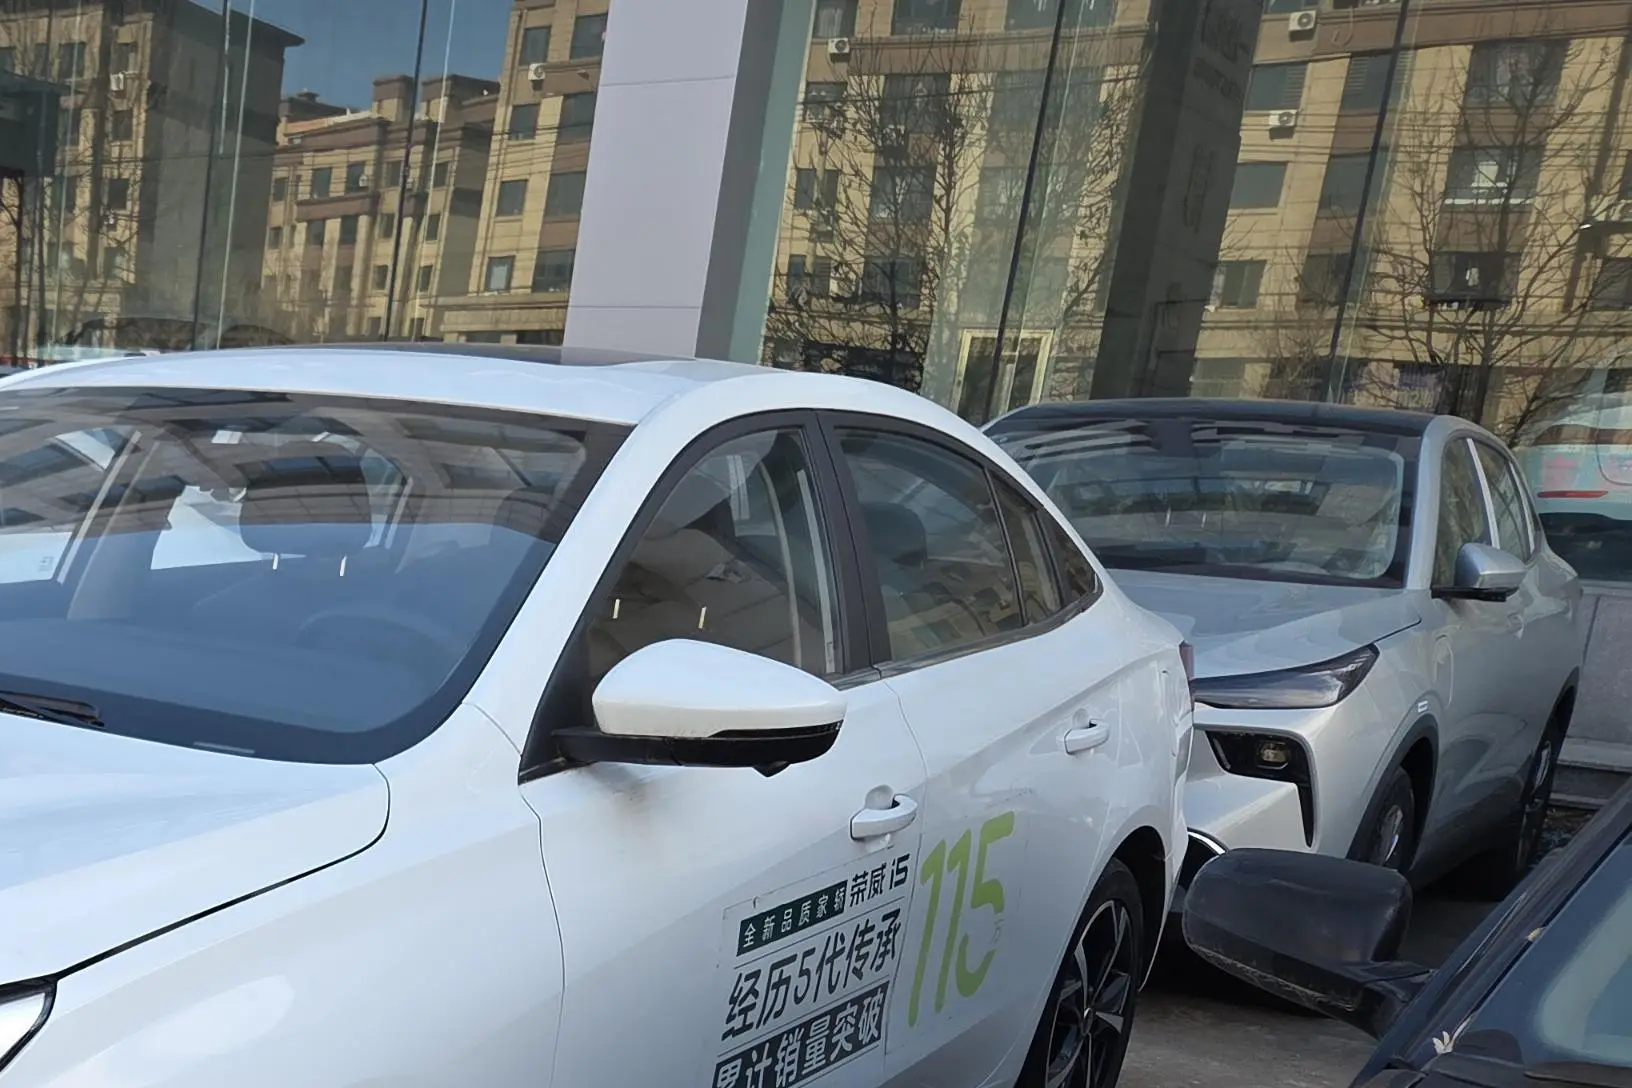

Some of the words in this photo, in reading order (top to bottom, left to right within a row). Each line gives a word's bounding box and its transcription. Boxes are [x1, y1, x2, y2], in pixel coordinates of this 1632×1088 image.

[743, 886, 846, 948] 全新品质家轿
[849, 853, 911, 908] 荣威i5
[909, 810, 1015, 1029] 115
[721, 907, 902, 1041] 经历5代传承
